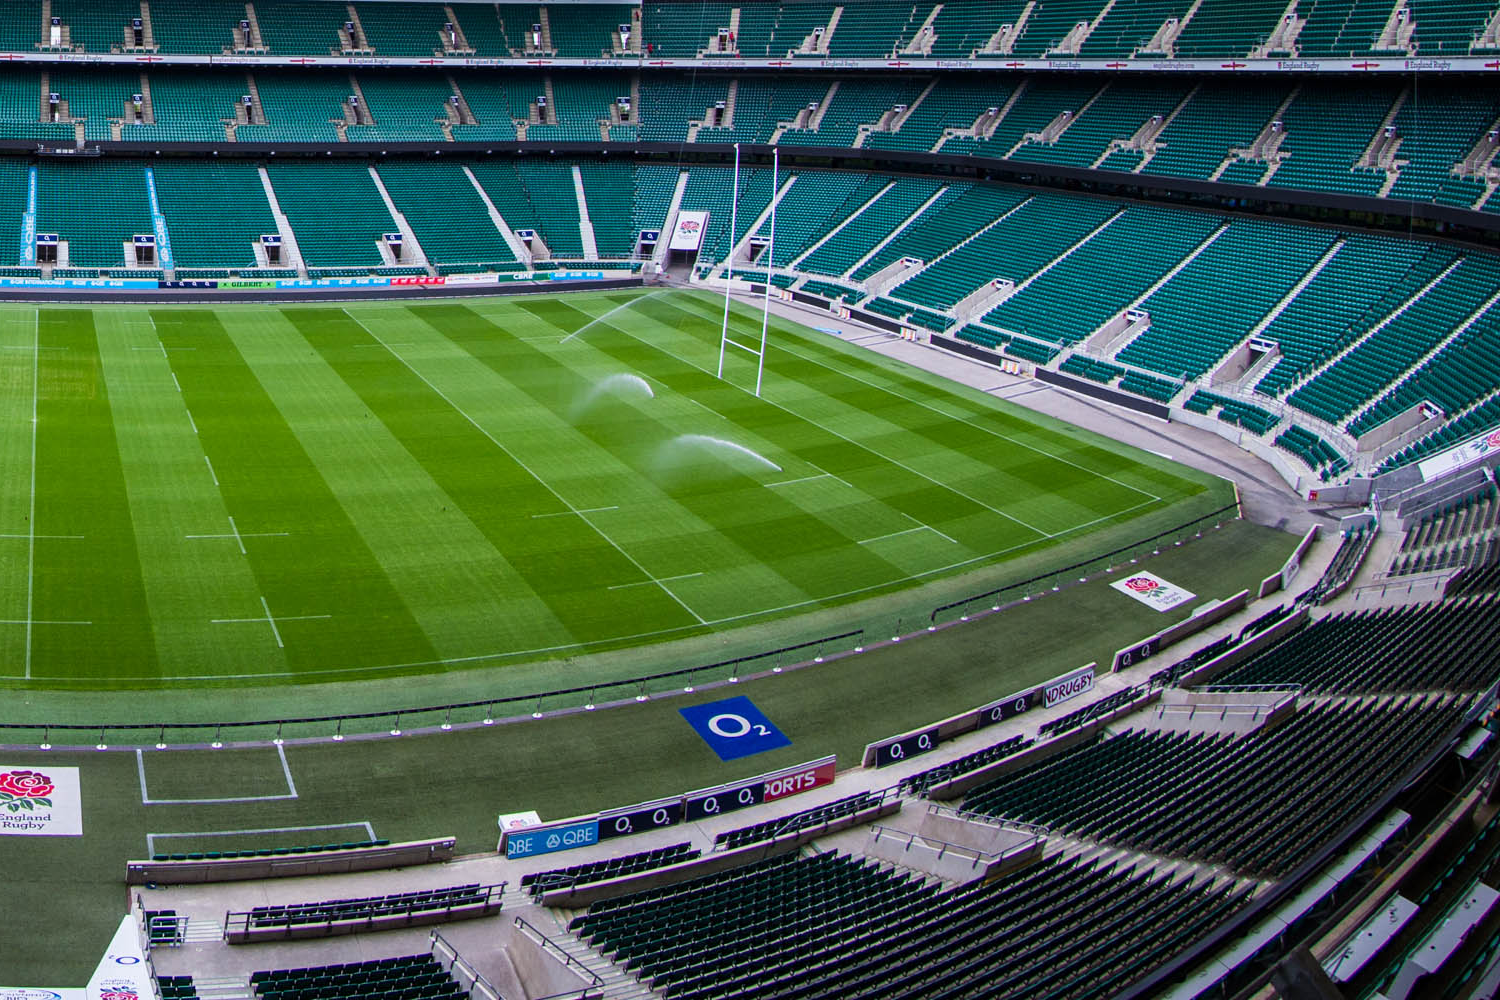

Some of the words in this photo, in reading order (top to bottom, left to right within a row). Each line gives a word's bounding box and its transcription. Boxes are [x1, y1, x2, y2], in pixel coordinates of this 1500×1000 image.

[1282, 61, 1302, 69] England
[1303, 61, 1320, 70] Rugby
[1410, 60, 1431, 69] England
[1433, 60, 1451, 69] Rugby
[707, 713, 771, 738] O2
[890, 743, 904, 759] O2
[918, 734, 931, 749] O2
[703, 797, 720, 813] O2
[738, 788, 754, 804] O2
[3, 821, 45, 830] Rugby
[615, 817, 633, 832] O2
[653, 809, 670, 824] O2
[563, 827, 593, 845] QBE
